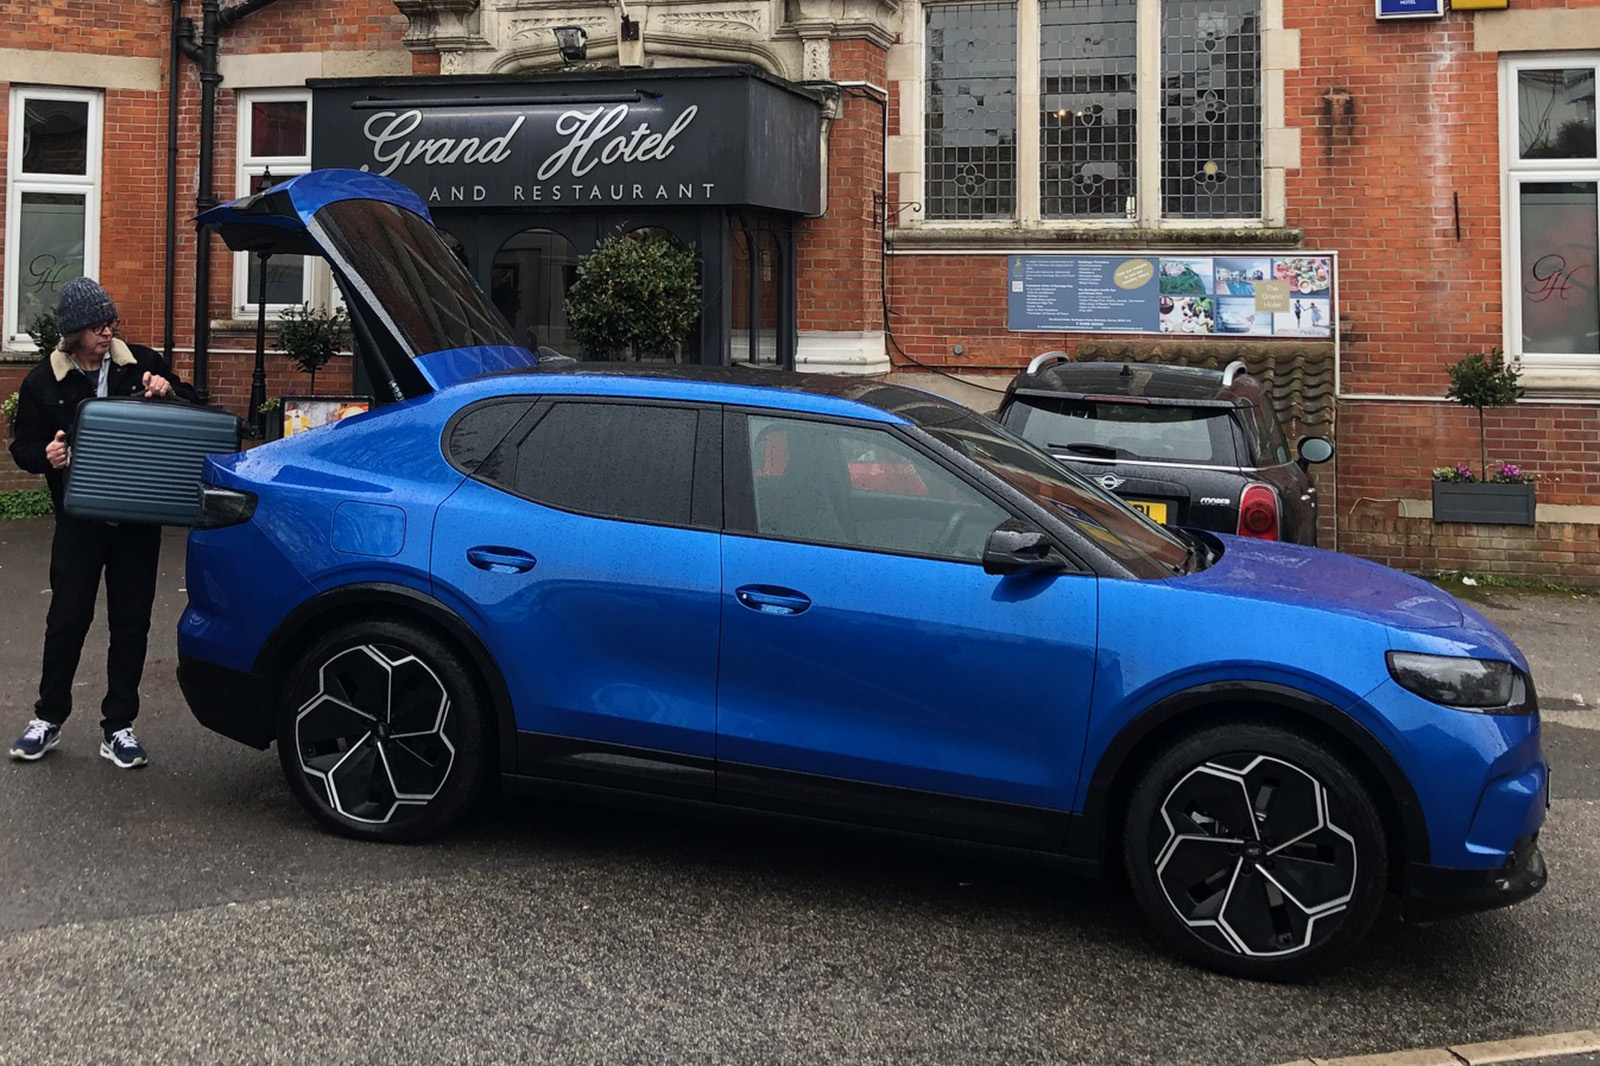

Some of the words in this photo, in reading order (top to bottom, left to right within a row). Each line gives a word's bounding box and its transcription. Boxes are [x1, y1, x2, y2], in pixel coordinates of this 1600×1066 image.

[360, 109, 526, 177] Grand
[536, 103, 699, 182] Hotel
[429, 185, 487, 202] AND
[513, 183, 716, 201] RESTAURANT
